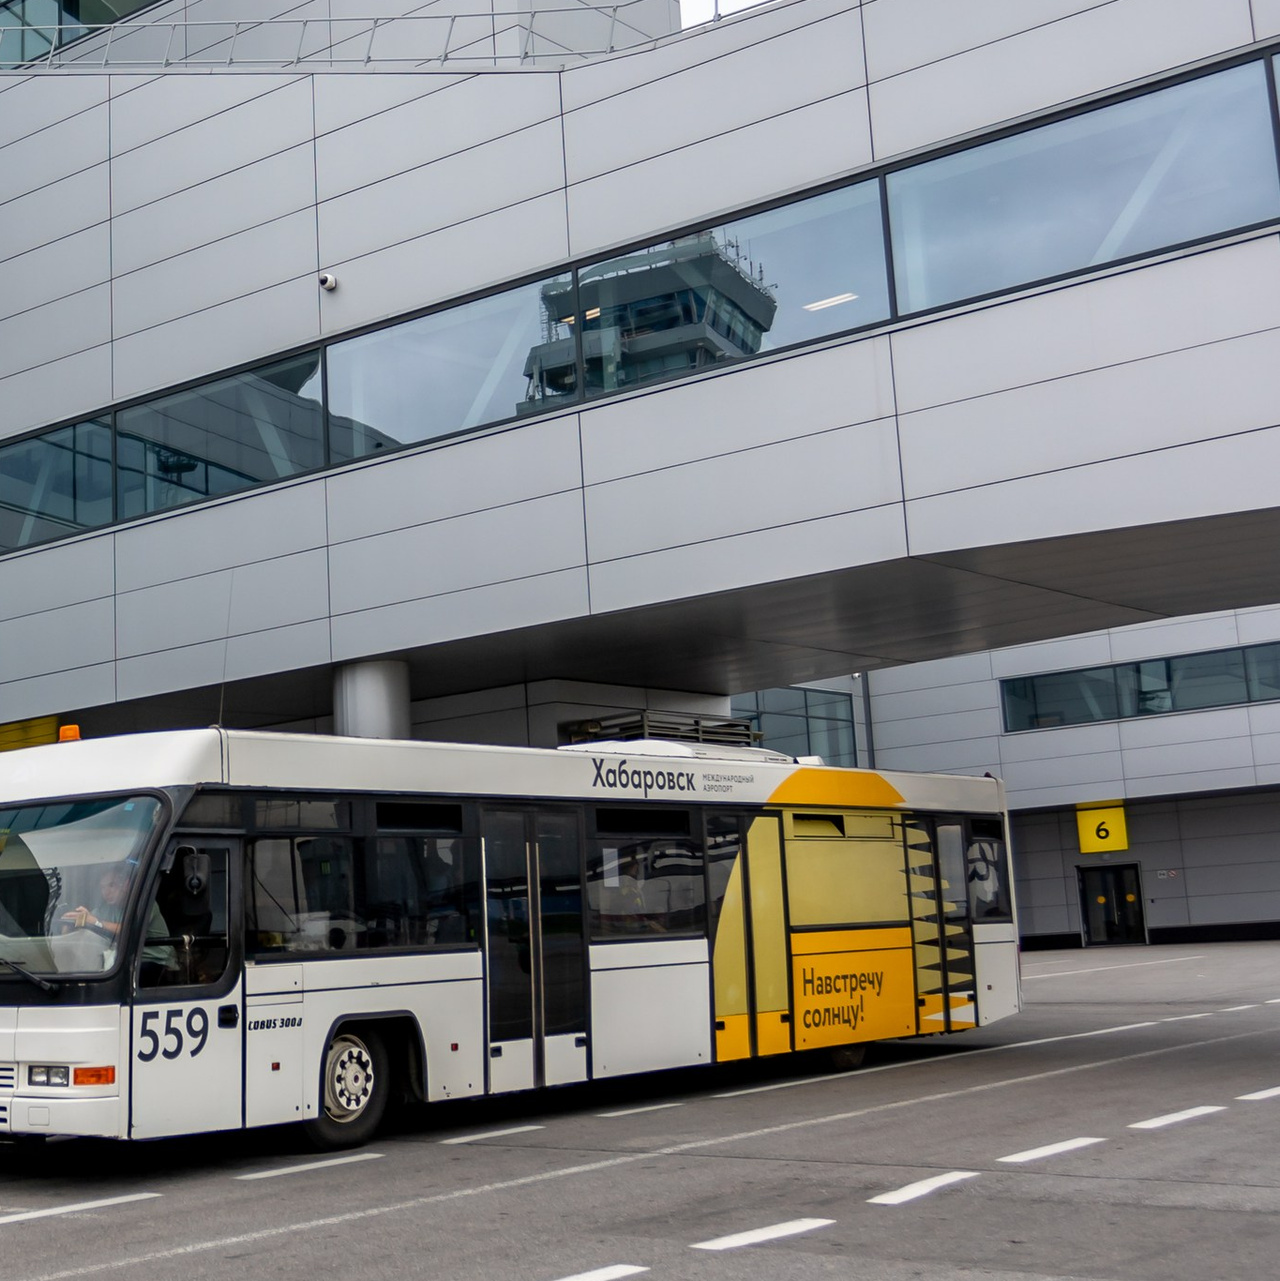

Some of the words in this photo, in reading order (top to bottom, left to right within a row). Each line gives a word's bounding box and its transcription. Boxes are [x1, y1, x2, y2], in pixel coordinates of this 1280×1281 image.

[592, 757, 696, 798] Хабаровск
[702, 773, 755, 784] МЕЖДУНАРОДНЫЙ
[703, 784, 733, 793] АЭРОПОРТ
[1096, 821, 1109, 839] 6
[803, 967, 883, 999] Навстречу
[803, 994, 864, 1030] солнцу!
[137, 1007, 209, 1062] 559
[248, 1019, 277, 1031] COBUS
